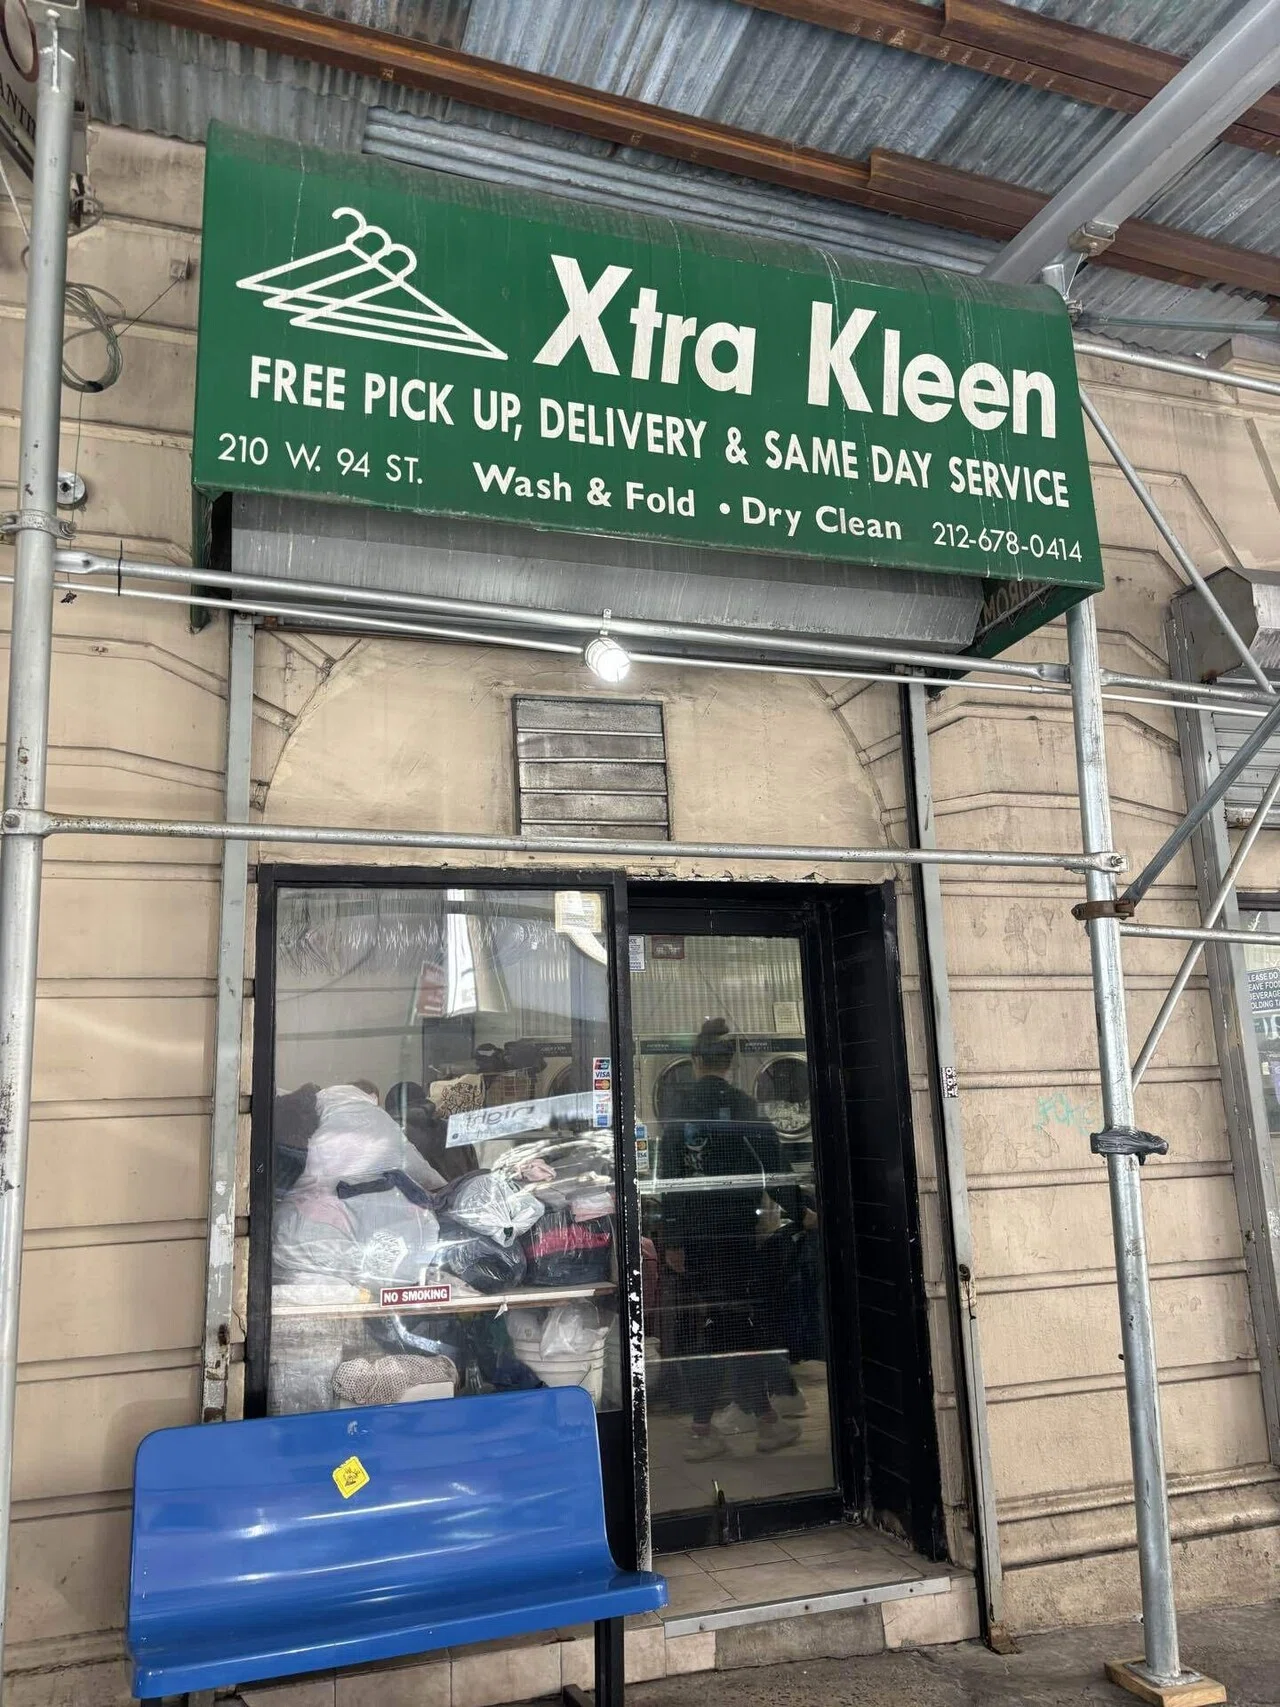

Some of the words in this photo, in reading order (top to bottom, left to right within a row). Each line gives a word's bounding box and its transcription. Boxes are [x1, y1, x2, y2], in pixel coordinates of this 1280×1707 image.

[533, 254, 757, 396] Xtra
[806, 300, 1057, 439] Kleen
[250, 355, 346, 411] FREE
[364, 373, 455, 425] PICK
[474, 388, 523, 442] UP,
[541, 398, 708, 459] DELIVERY
[725, 427, 750, 466] &
[764, 431, 859, 480] SAME
[872, 445, 933, 489] DAY
[949, 457, 1070, 508] SERVICE
[218, 433, 269, 466] 210
[285, 442, 321, 472] W.
[337, 448, 371, 478] 94
[386, 454, 424, 485] ST.
[473, 462, 573, 503] Wash
[587, 477, 612, 508] &
[627, 482, 696, 518] Fold
[742, 497, 802, 537] Dry
[816, 506, 903, 541] Clean
[933, 521, 1083, 563] 212-678-0414
[1268, 972, 1278, 980] DO
[383, 1292, 399, 1303] NO
[401, 1288, 448, 1302] SMOKING
